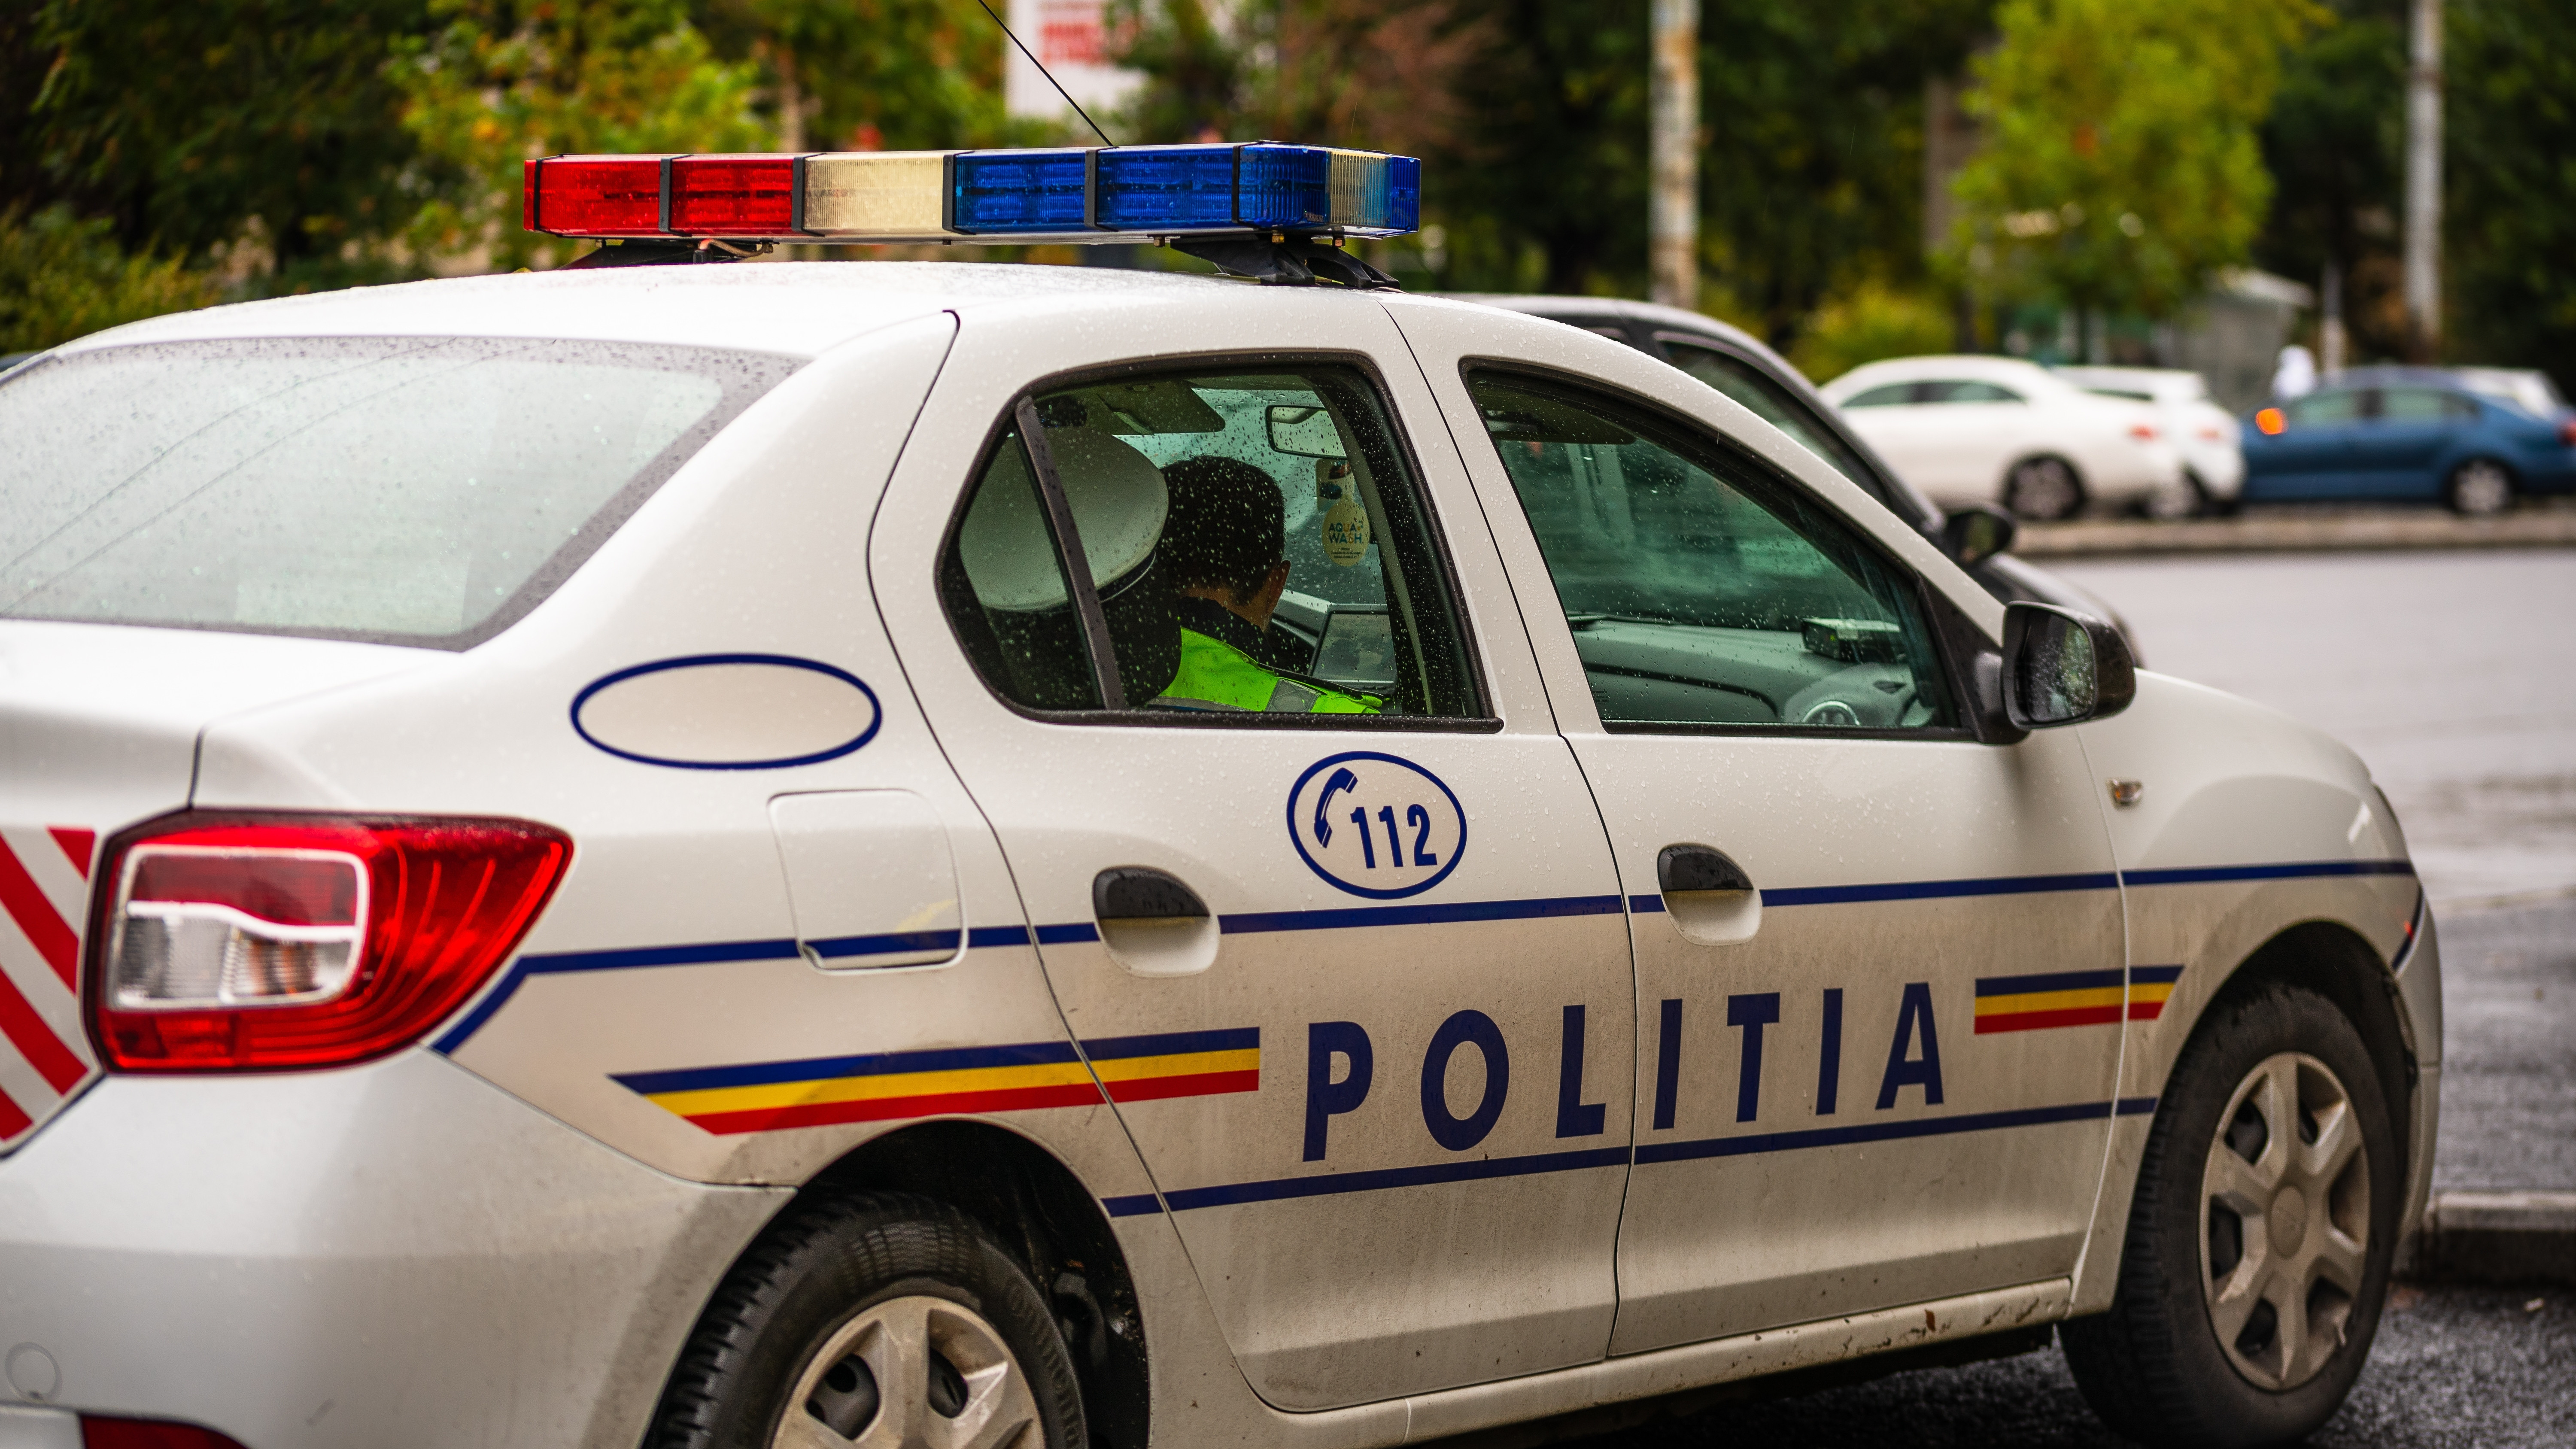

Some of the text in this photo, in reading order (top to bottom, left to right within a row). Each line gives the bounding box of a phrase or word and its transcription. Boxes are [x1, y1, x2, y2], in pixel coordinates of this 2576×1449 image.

[1328, 522, 1357, 532] AQUA
[1328, 533, 1362, 544] WASH
[1350, 804, 1437, 869] 112
[1302, 982, 1944, 1162] POLITIA
